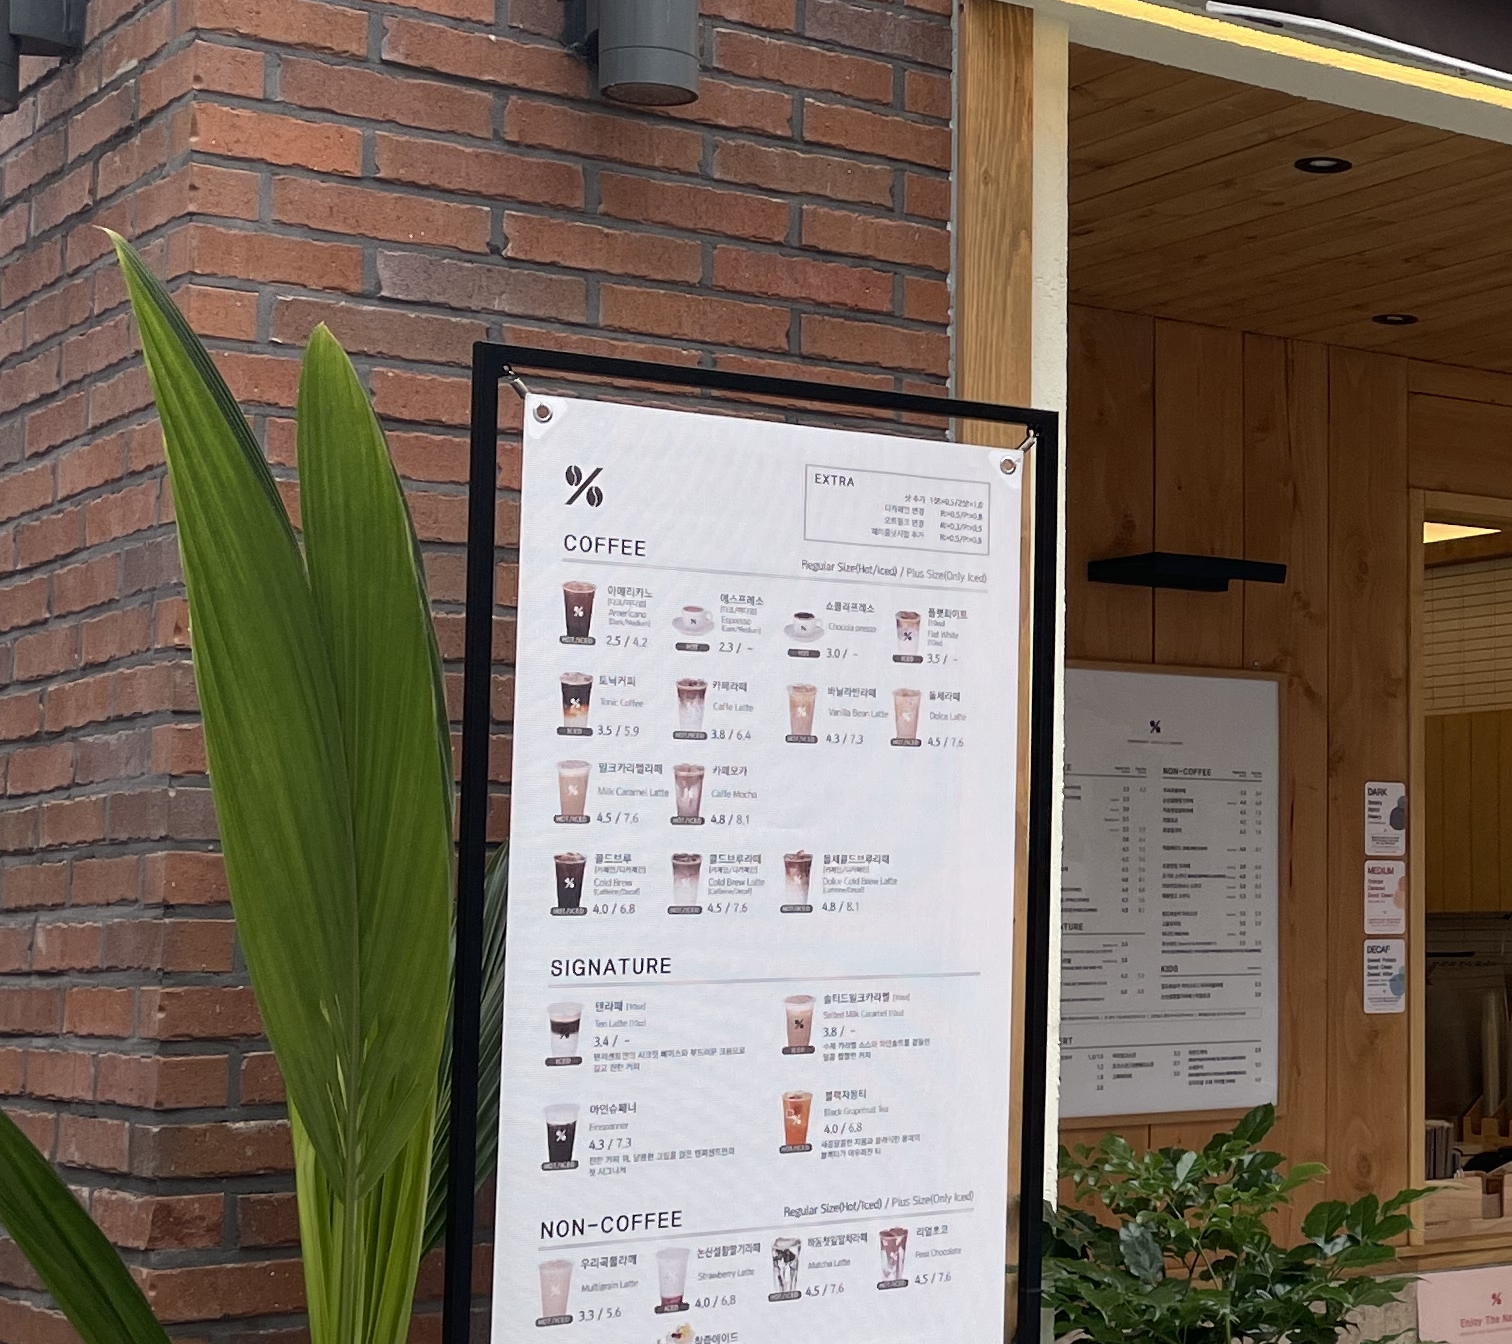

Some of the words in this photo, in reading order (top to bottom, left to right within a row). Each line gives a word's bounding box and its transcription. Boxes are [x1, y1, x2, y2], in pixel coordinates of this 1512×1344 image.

[814, 473, 855, 487] EXTRA
[564, 535, 646, 557] COFFEE
[801, 560, 835, 572] Regular
[607, 585, 654, 598] 아메리카노
[606, 635, 620, 645] 2.5
[633, 636, 648, 647] 4.2
[826, 648, 840, 658] 3.0
[599, 676, 636, 687] 토닉커피
[711, 730, 725, 739] 3.8
[736, 730, 751, 740] 6.4
[927, 737, 940, 746] 4.5
[951, 737, 964, 747] 7.6
[1367, 788, 1388, 796] DARK
[711, 814, 725, 825] 4.8
[736, 815, 750, 825] 8.1
[1368, 866, 1394, 875] MEDIUM
[708, 903, 722, 913] 4.5
[734, 903, 747, 913] 7.6
[551, 957, 672, 977] SIGNATURE
[823, 1027, 837, 1038] 3.8
[594, 1036, 609, 1047] 3.4
[589, 1139, 605, 1150] 4.3
[617, 1138, 632, 1148] 7.3
[783, 1206, 817, 1218] Regular
[540, 1210, 683, 1239] NON-COFFEE
[579, 1311, 594, 1322] 3.3
[606, 1307, 621, 1318] 5.6
